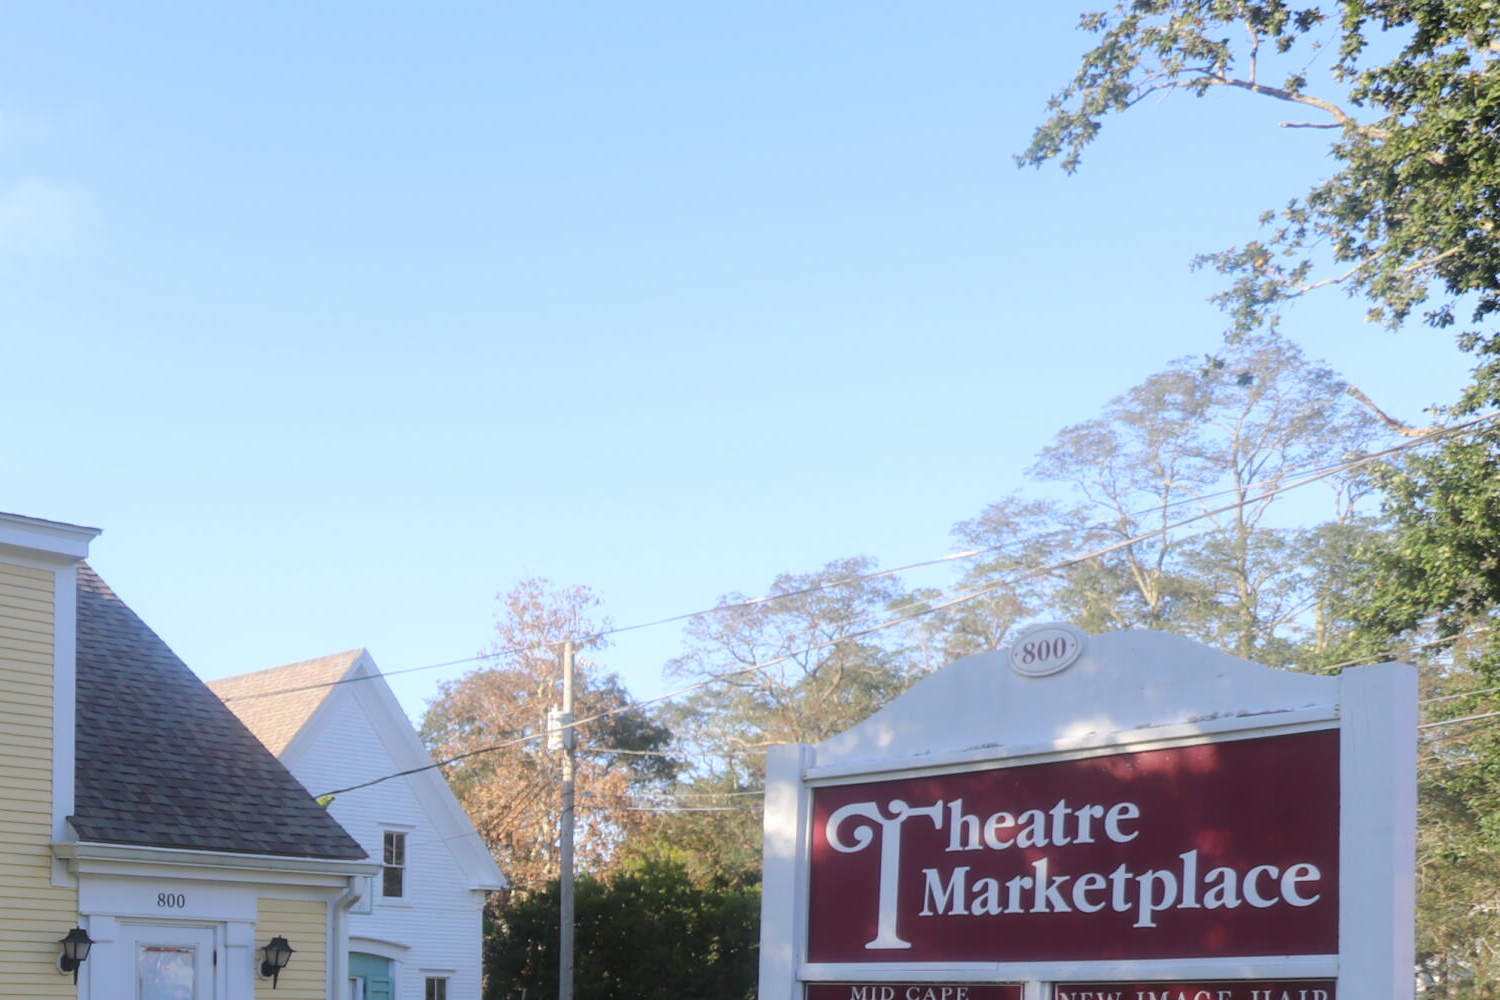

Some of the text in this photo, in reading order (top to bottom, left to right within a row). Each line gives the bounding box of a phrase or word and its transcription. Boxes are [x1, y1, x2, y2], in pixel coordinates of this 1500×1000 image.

[1021, 635, 1068, 664] 800
[825, 797, 1141, 950] Theatre
[157, 893, 185, 908] 800
[919, 848, 1321, 930] Marketplace
[850, 986, 894, 1000] MID
